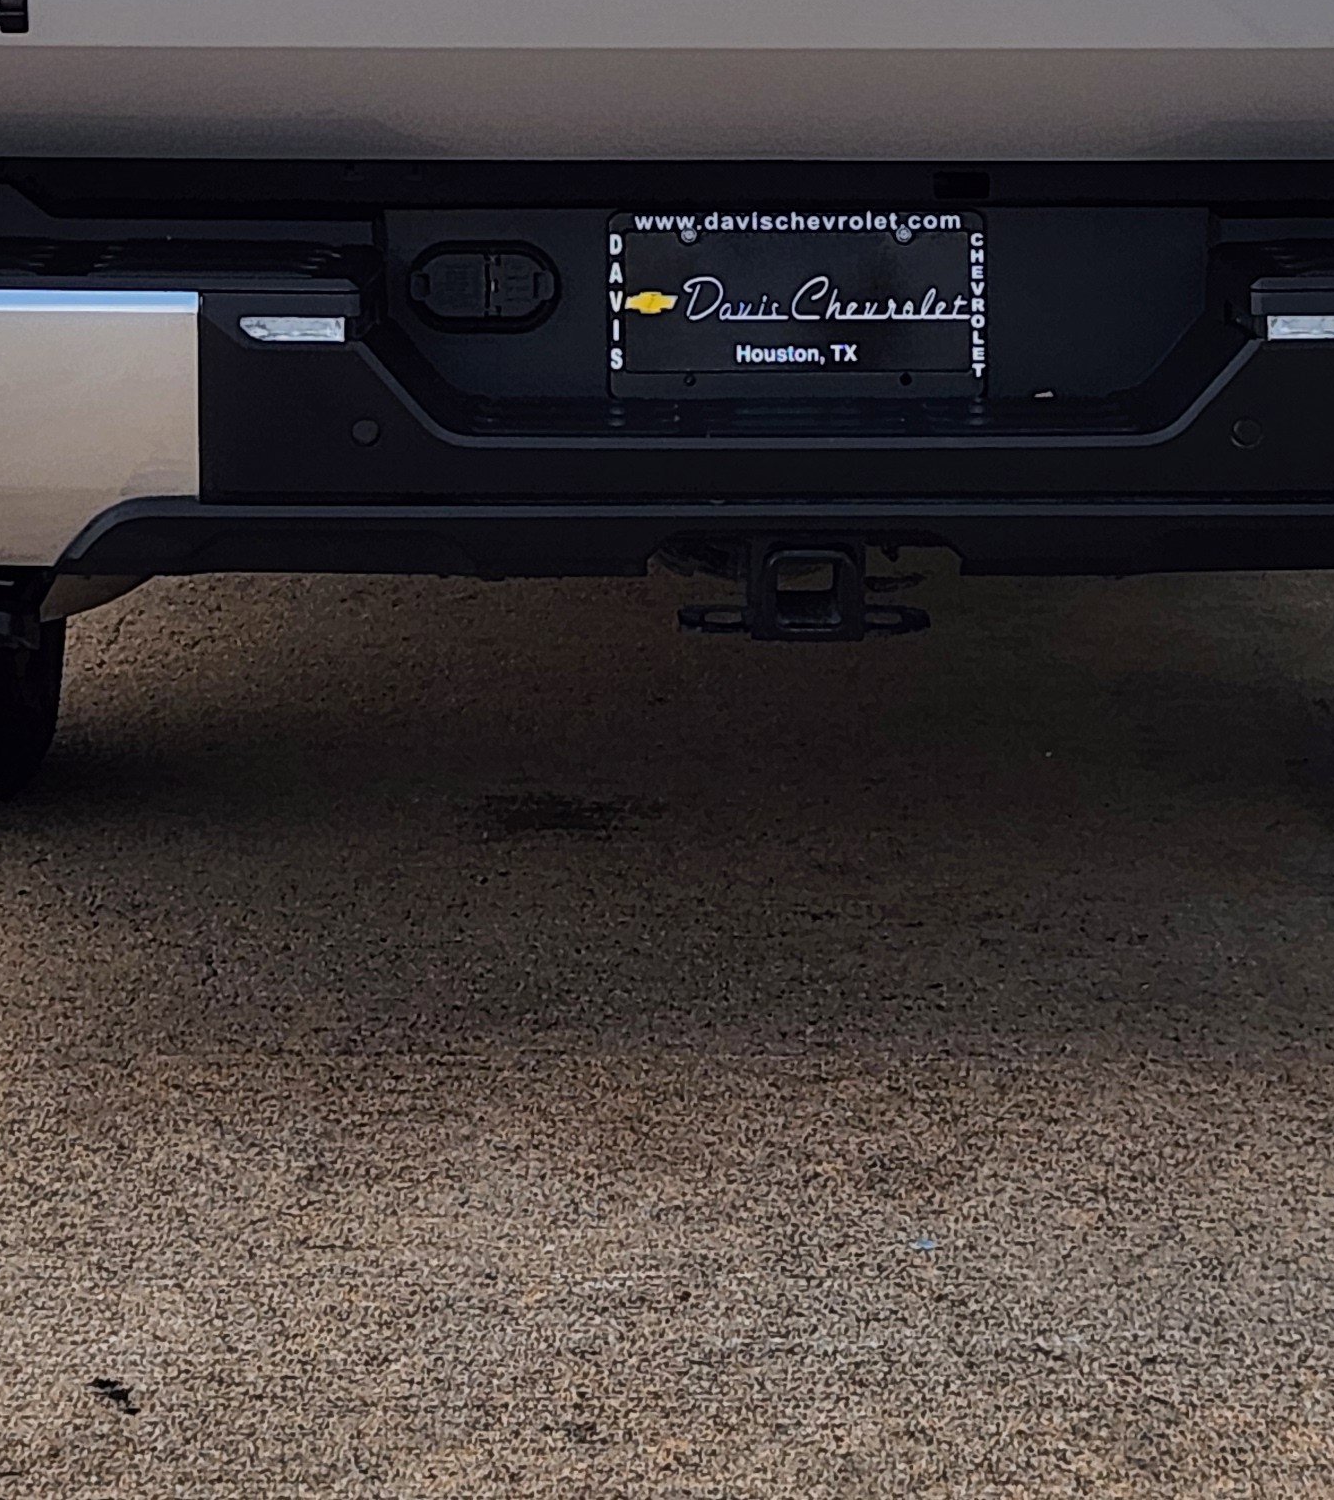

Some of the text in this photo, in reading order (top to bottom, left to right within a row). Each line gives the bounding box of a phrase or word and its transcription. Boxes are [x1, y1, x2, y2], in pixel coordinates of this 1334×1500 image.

[634, 211, 961, 232] www.davischevrolet.com
[609, 234, 623, 370] DAVIS
[683, 276, 789, 321] Davis
[791, 275, 970, 320] Chevrolet
[970, 233, 984, 377] CHEVROLET
[736, 345, 858, 365] Houston, TX
